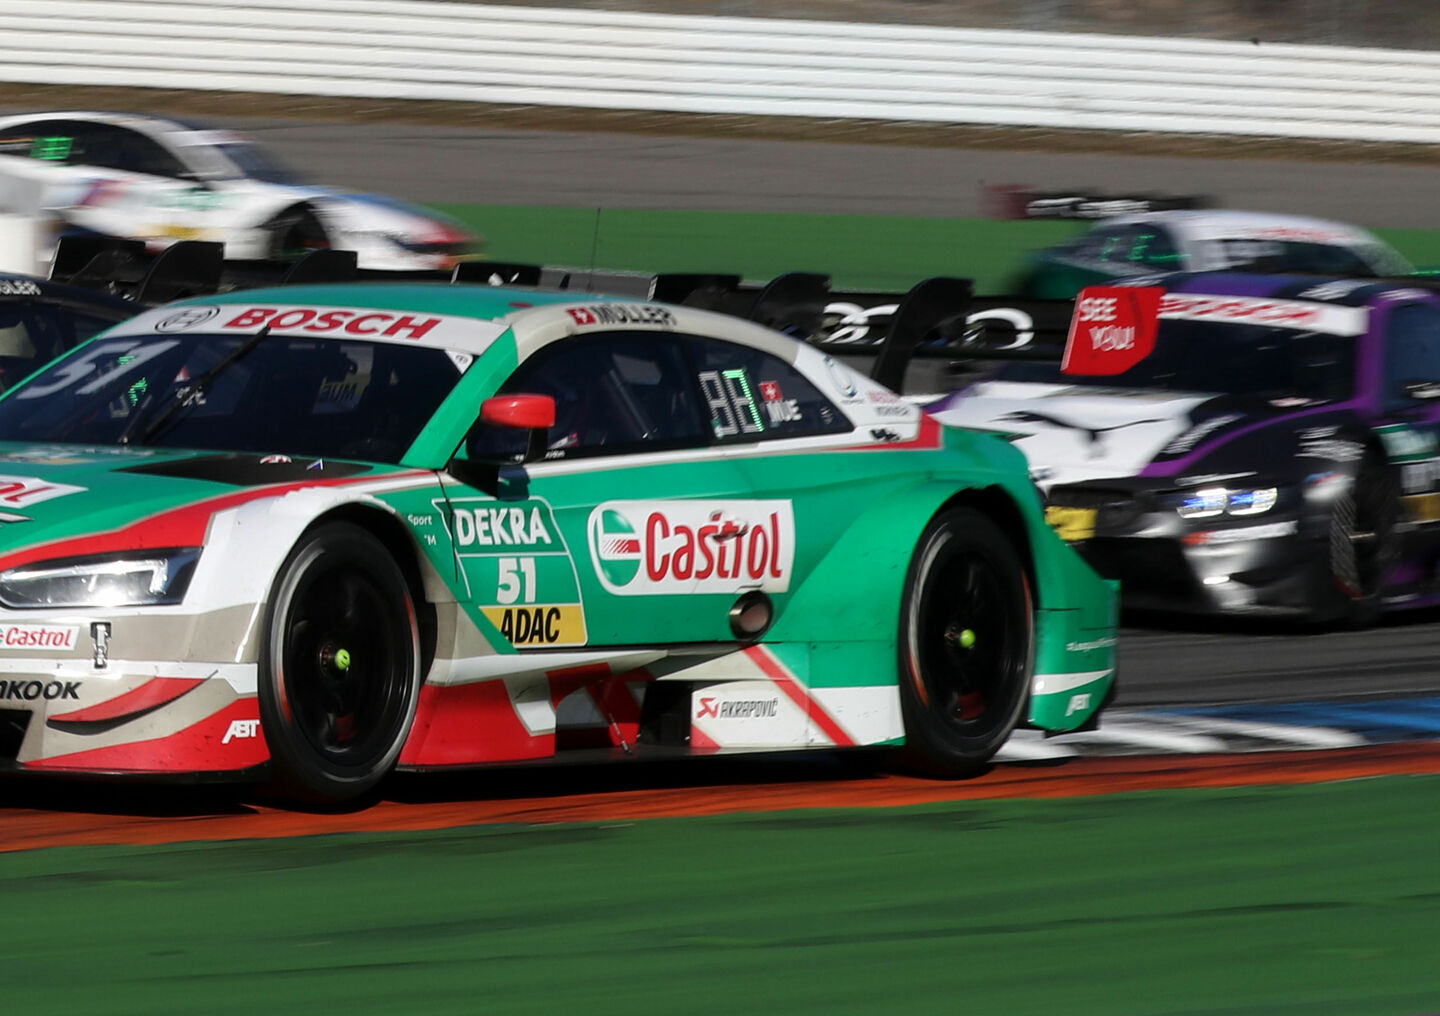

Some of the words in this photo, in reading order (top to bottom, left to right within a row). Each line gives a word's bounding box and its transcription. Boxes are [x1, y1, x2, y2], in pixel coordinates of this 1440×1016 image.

[223, 309, 440, 340] BOSCH
[589, 301, 678, 326] MÜLLER
[1079, 297, 1118, 322] SEE
[16, 340, 181, 400] 51
[456, 508, 552, 546] DEKRA
[645, 511, 783, 583] Castrol
[497, 556, 537, 603] 51
[5, 626, 73, 648] Castrol
[500, 606, 561, 644] ADAC
[222, 719, 261, 745] ABT
